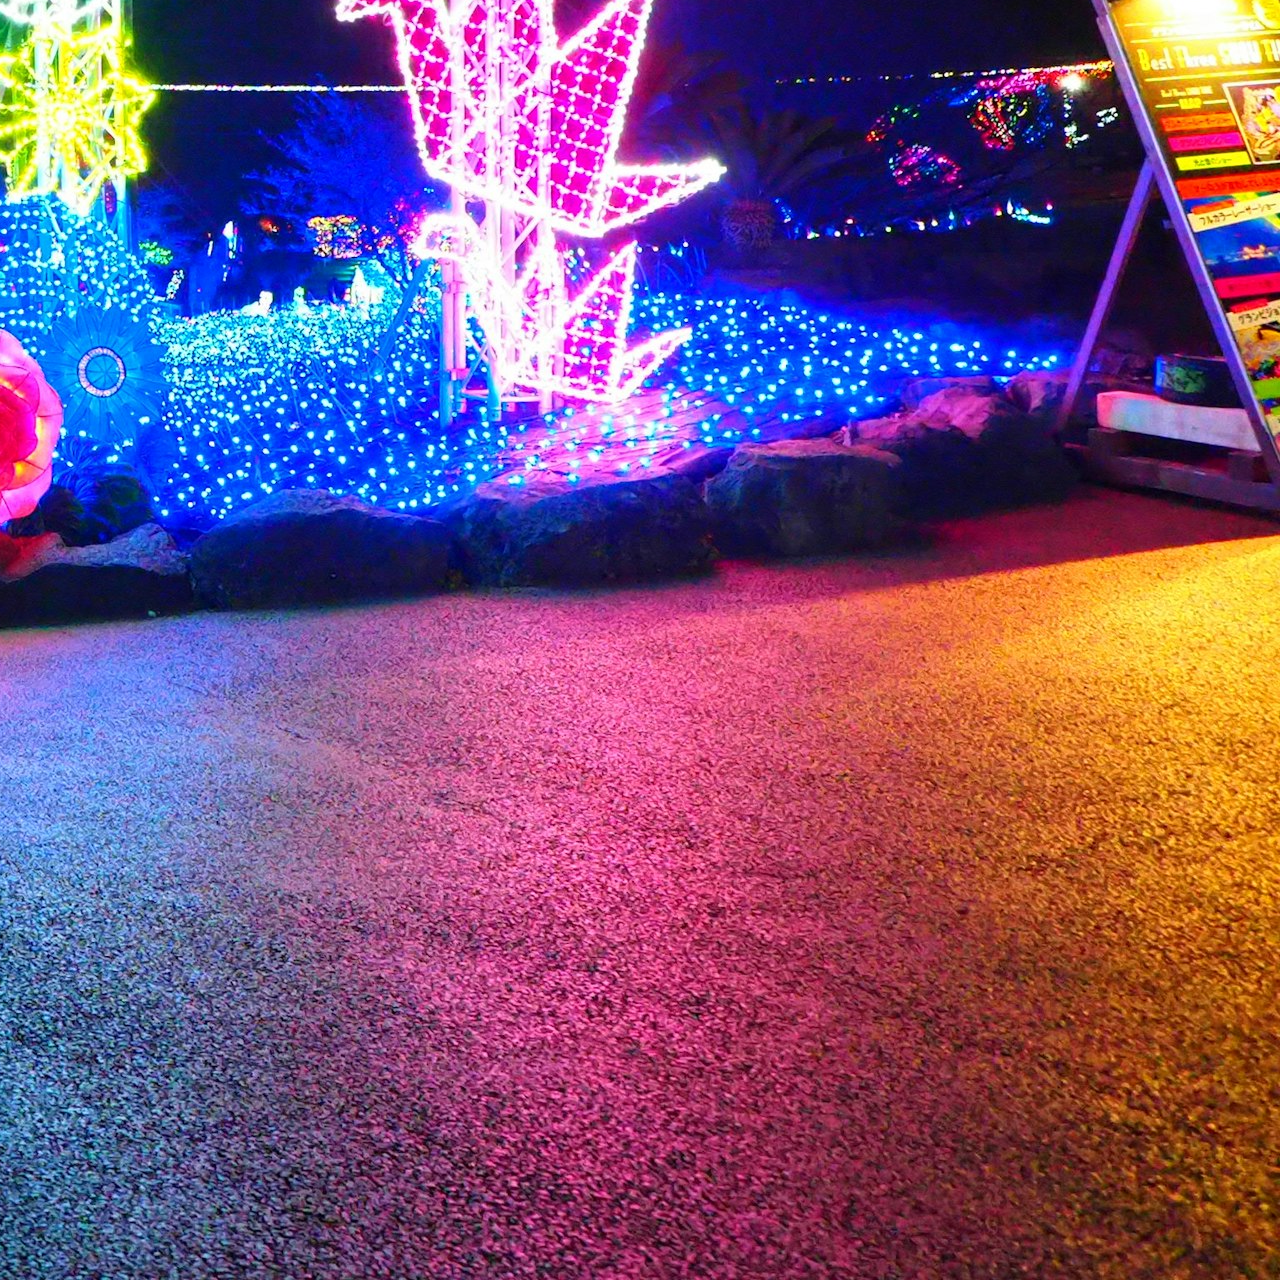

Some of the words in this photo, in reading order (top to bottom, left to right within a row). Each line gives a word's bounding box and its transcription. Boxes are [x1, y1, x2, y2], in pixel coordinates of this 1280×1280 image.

[1137, 47, 1174, 70] Best
[1173, 45, 1217, 68] Three
[1199, 203, 1277, 225] フルカラーレーザーショー
[1238, 305, 1280, 325] グランビジョ
